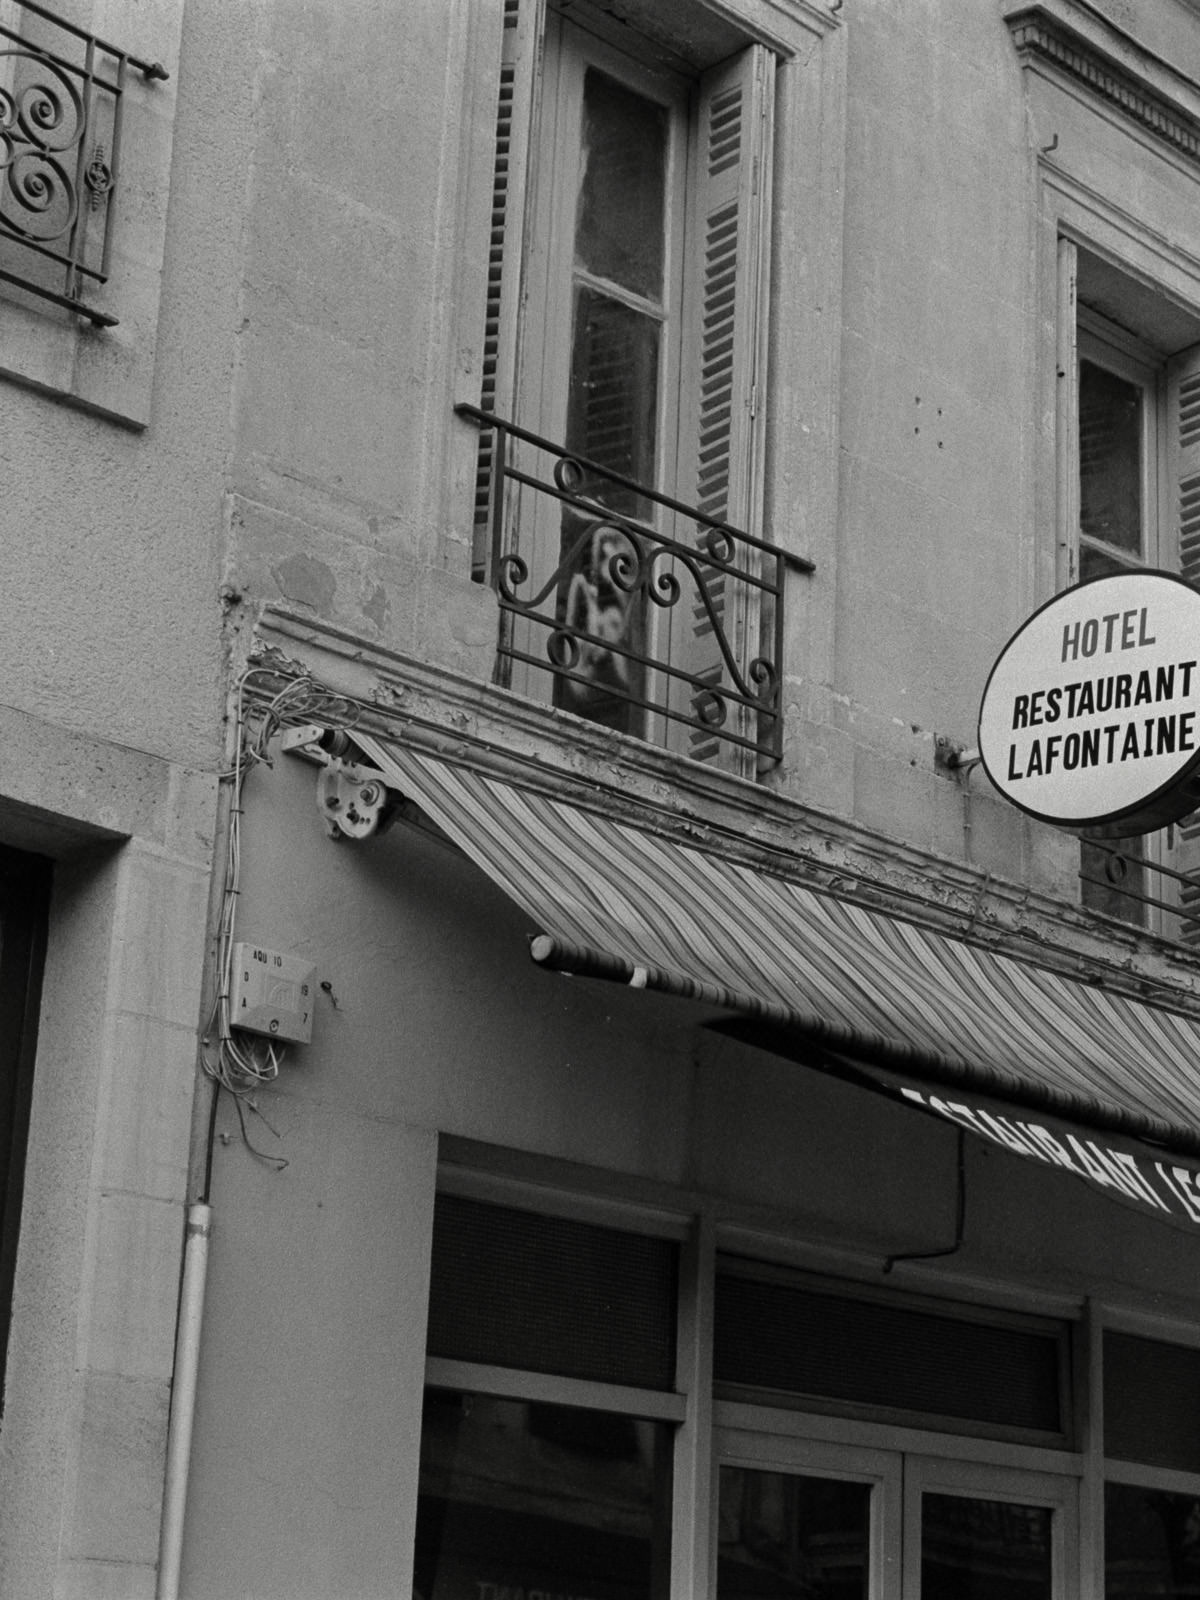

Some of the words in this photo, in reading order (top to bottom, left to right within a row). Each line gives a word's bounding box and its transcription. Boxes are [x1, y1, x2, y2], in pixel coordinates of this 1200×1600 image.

[1061, 607, 1156, 663] HOTEL
[1012, 660, 1197, 730] RESTAURANT
[1007, 711, 1196, 781] LAFONTAINE
[900, 1087, 1172, 1214] STAURANT
